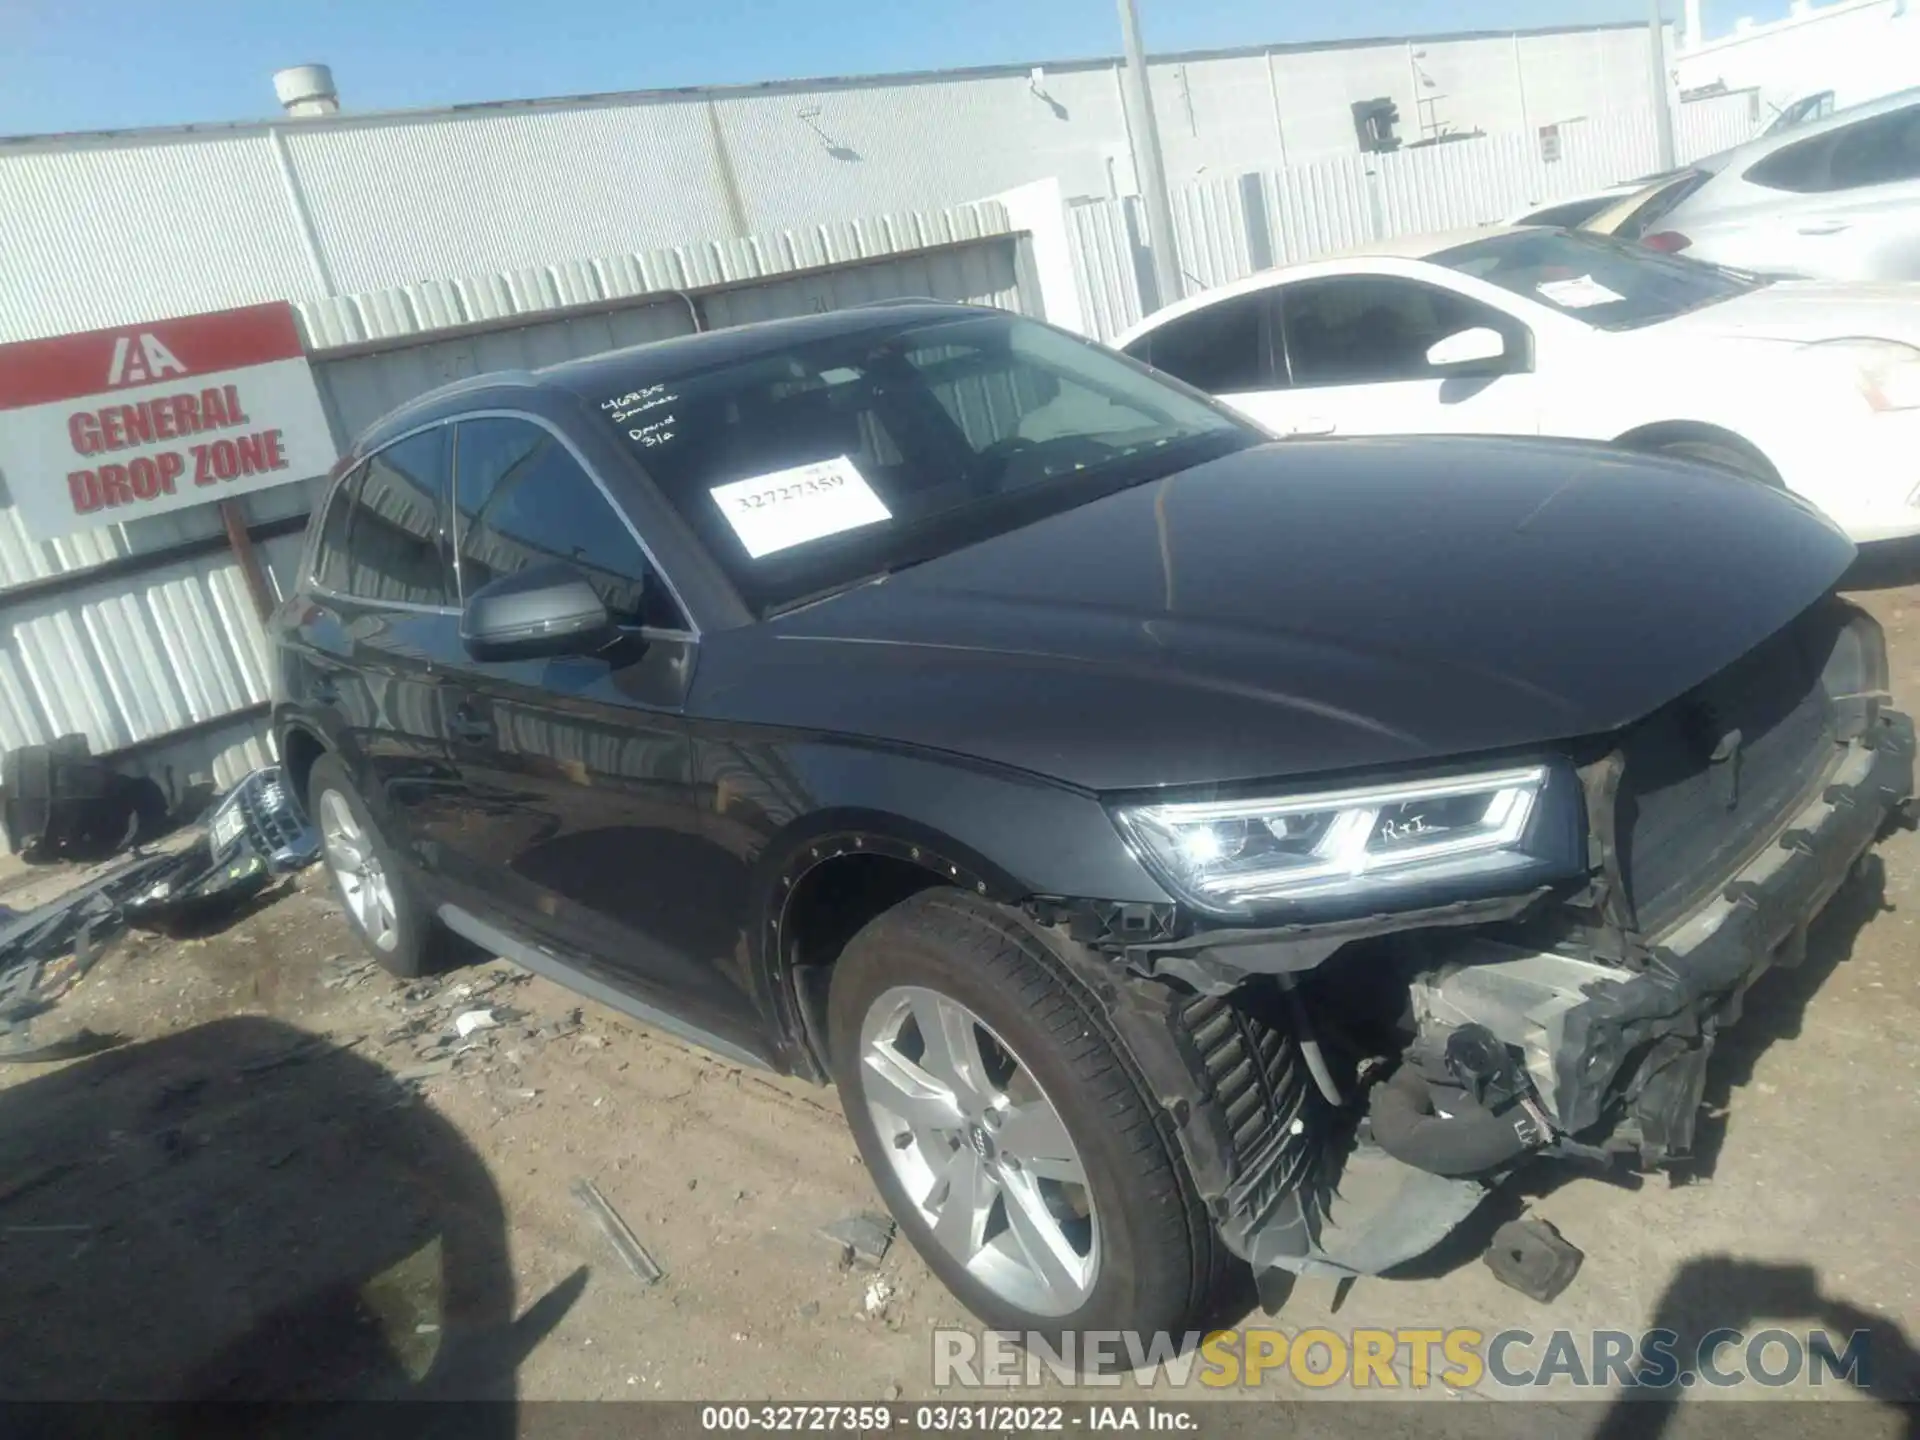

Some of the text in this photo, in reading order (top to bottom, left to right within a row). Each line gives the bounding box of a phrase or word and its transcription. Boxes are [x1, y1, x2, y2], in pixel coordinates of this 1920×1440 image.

[67, 384, 250, 458] GENERAL
[67, 429, 289, 515] DROP ZONE
[735, 474, 845, 513] 32727359
